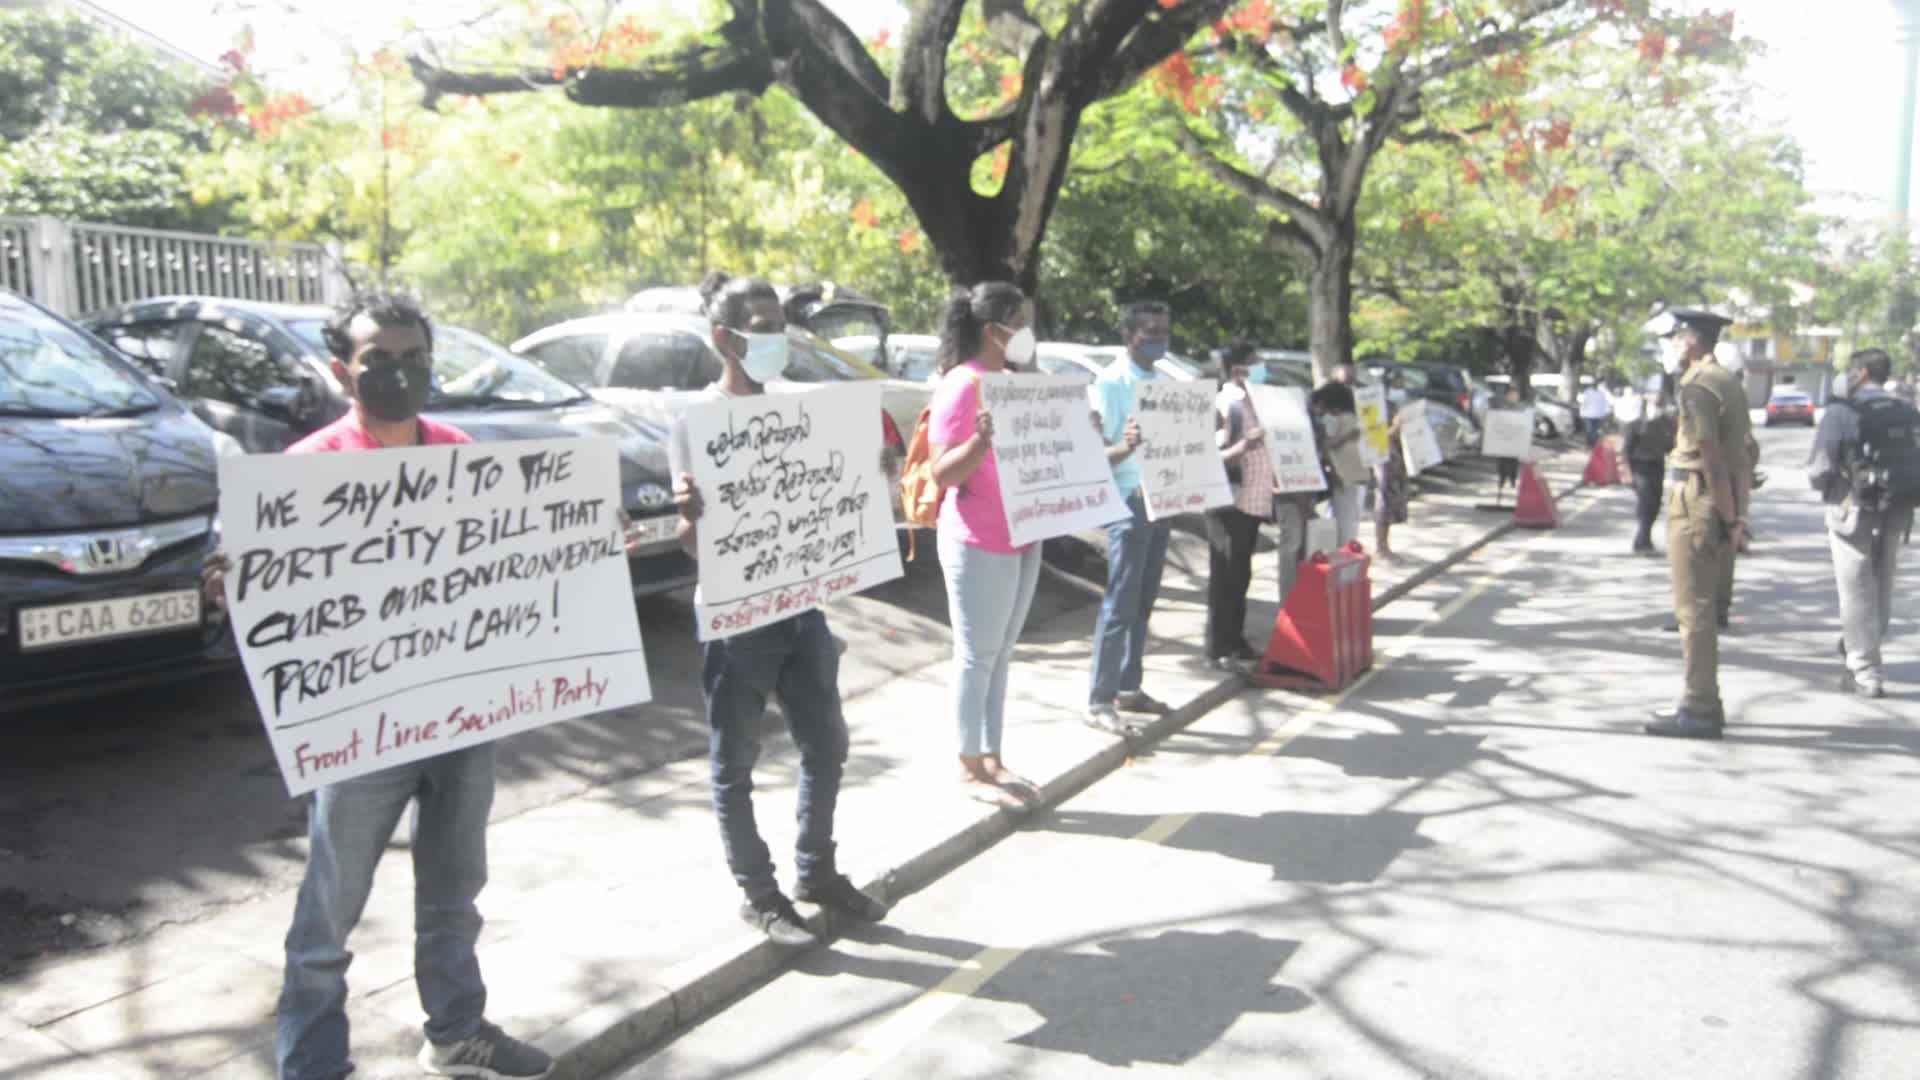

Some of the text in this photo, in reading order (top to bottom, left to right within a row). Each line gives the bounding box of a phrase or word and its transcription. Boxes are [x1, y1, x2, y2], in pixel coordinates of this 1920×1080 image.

[257, 490, 297, 531] WE
[320, 479, 390, 528] SAY
[467, 455, 503, 496] TO
[520, 451, 574, 494] THE
[237, 544, 347, 601] PORT
[543, 498, 605, 532] THAT
[247, 531, 622, 648] CURB OUR ENVIRONMENTAL
[57, 606, 114, 636] CAA
[129, 595, 194, 626] 6203
[263, 621, 456, 718] PROTECTION
[293, 668, 609, 778] Front Line Socialist Party
